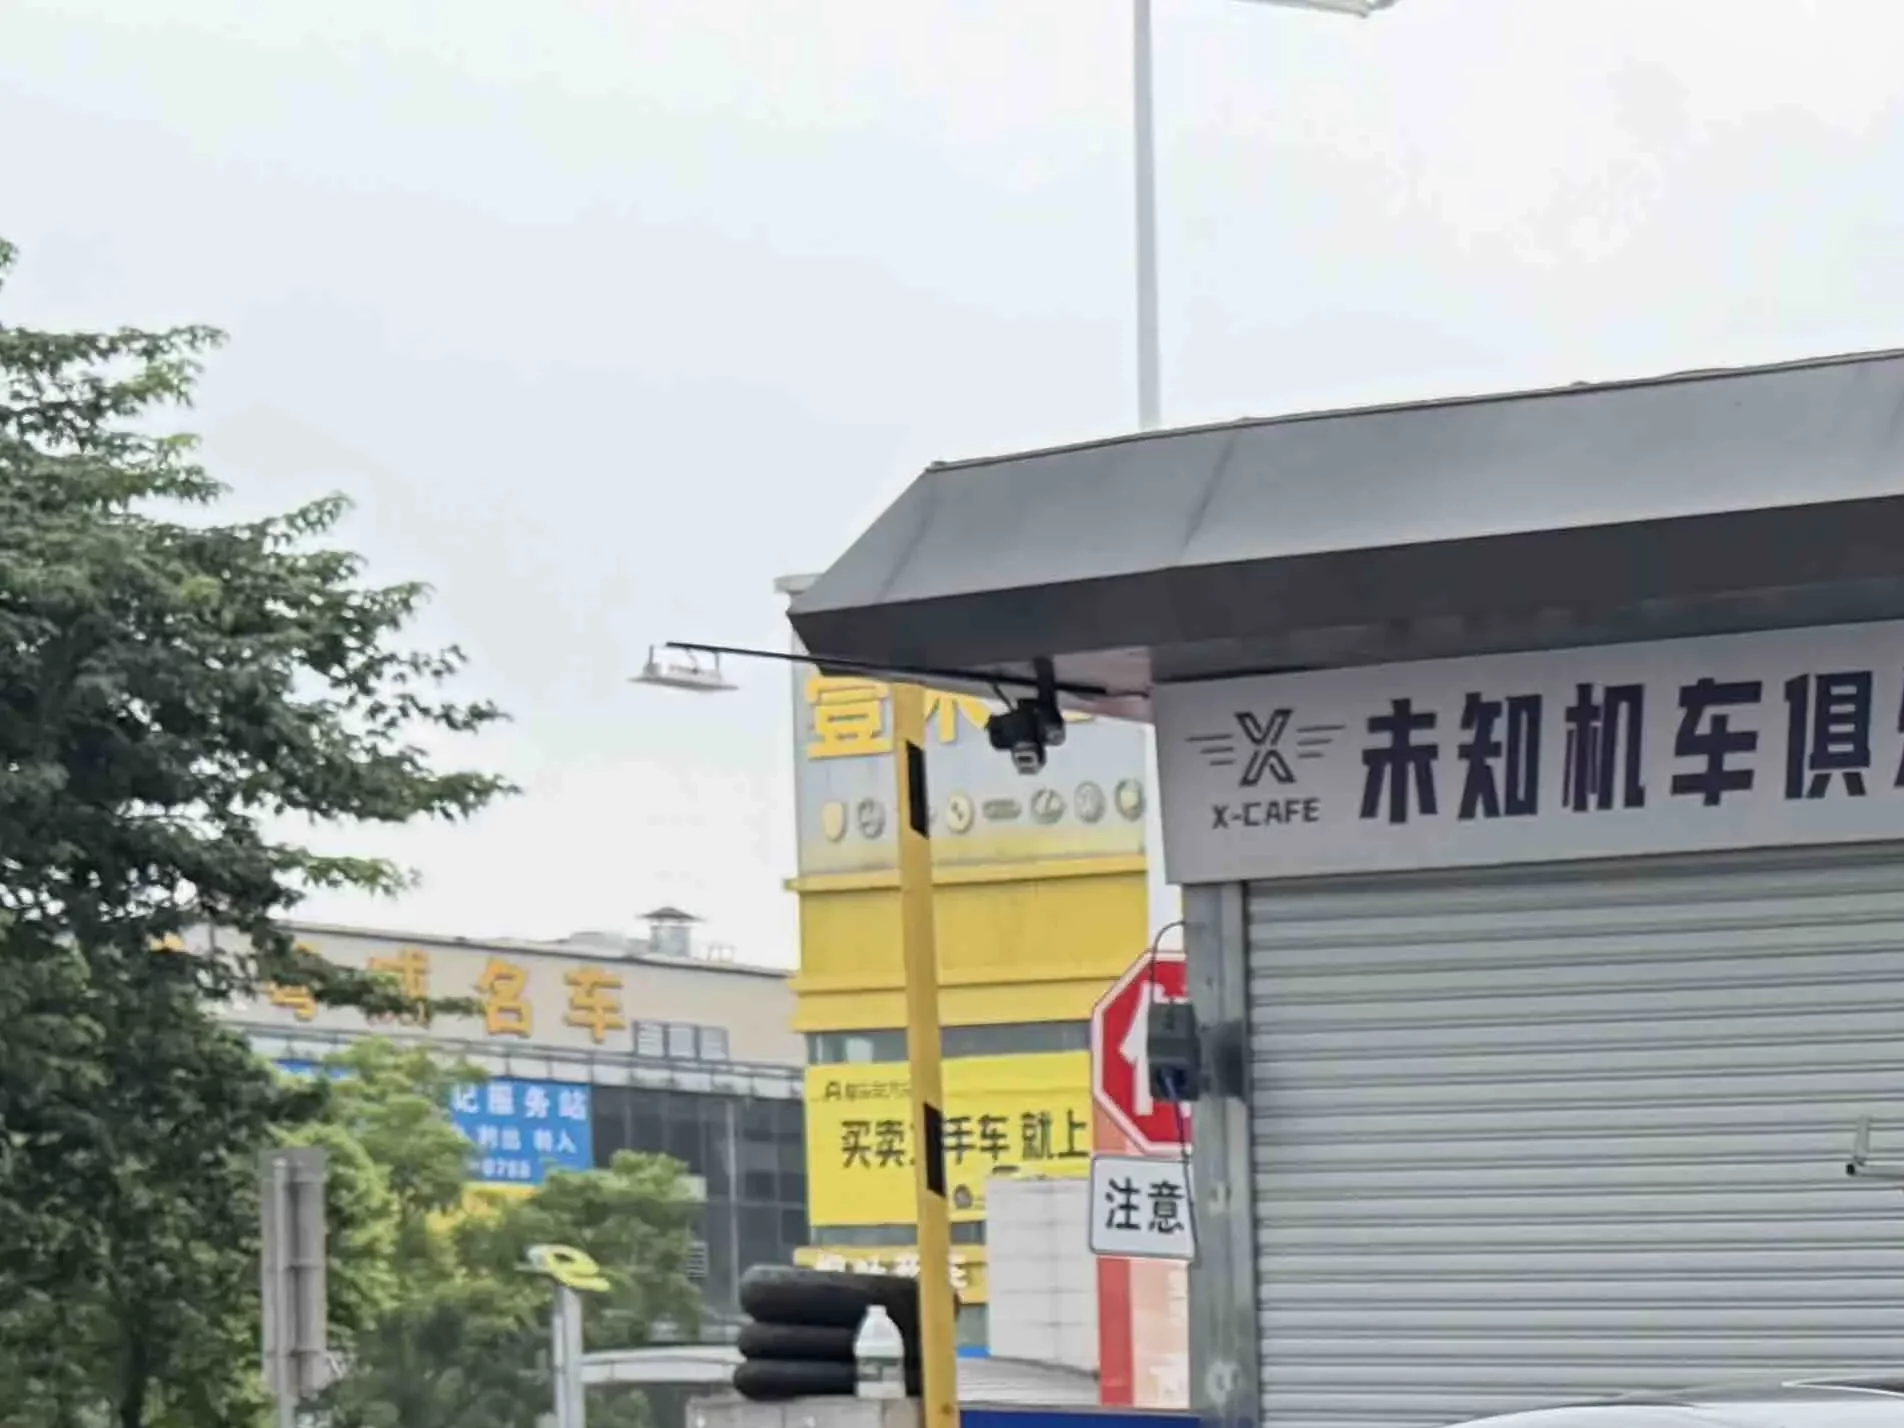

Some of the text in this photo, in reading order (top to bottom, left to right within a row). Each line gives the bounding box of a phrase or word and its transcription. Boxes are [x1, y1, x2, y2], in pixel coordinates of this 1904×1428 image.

[1211, 796, 1320, 831] X-CAFE
[841, 1110, 1089, 1170] 买卖手车 就上
[1104, 1178, 1185, 1233] 注意
